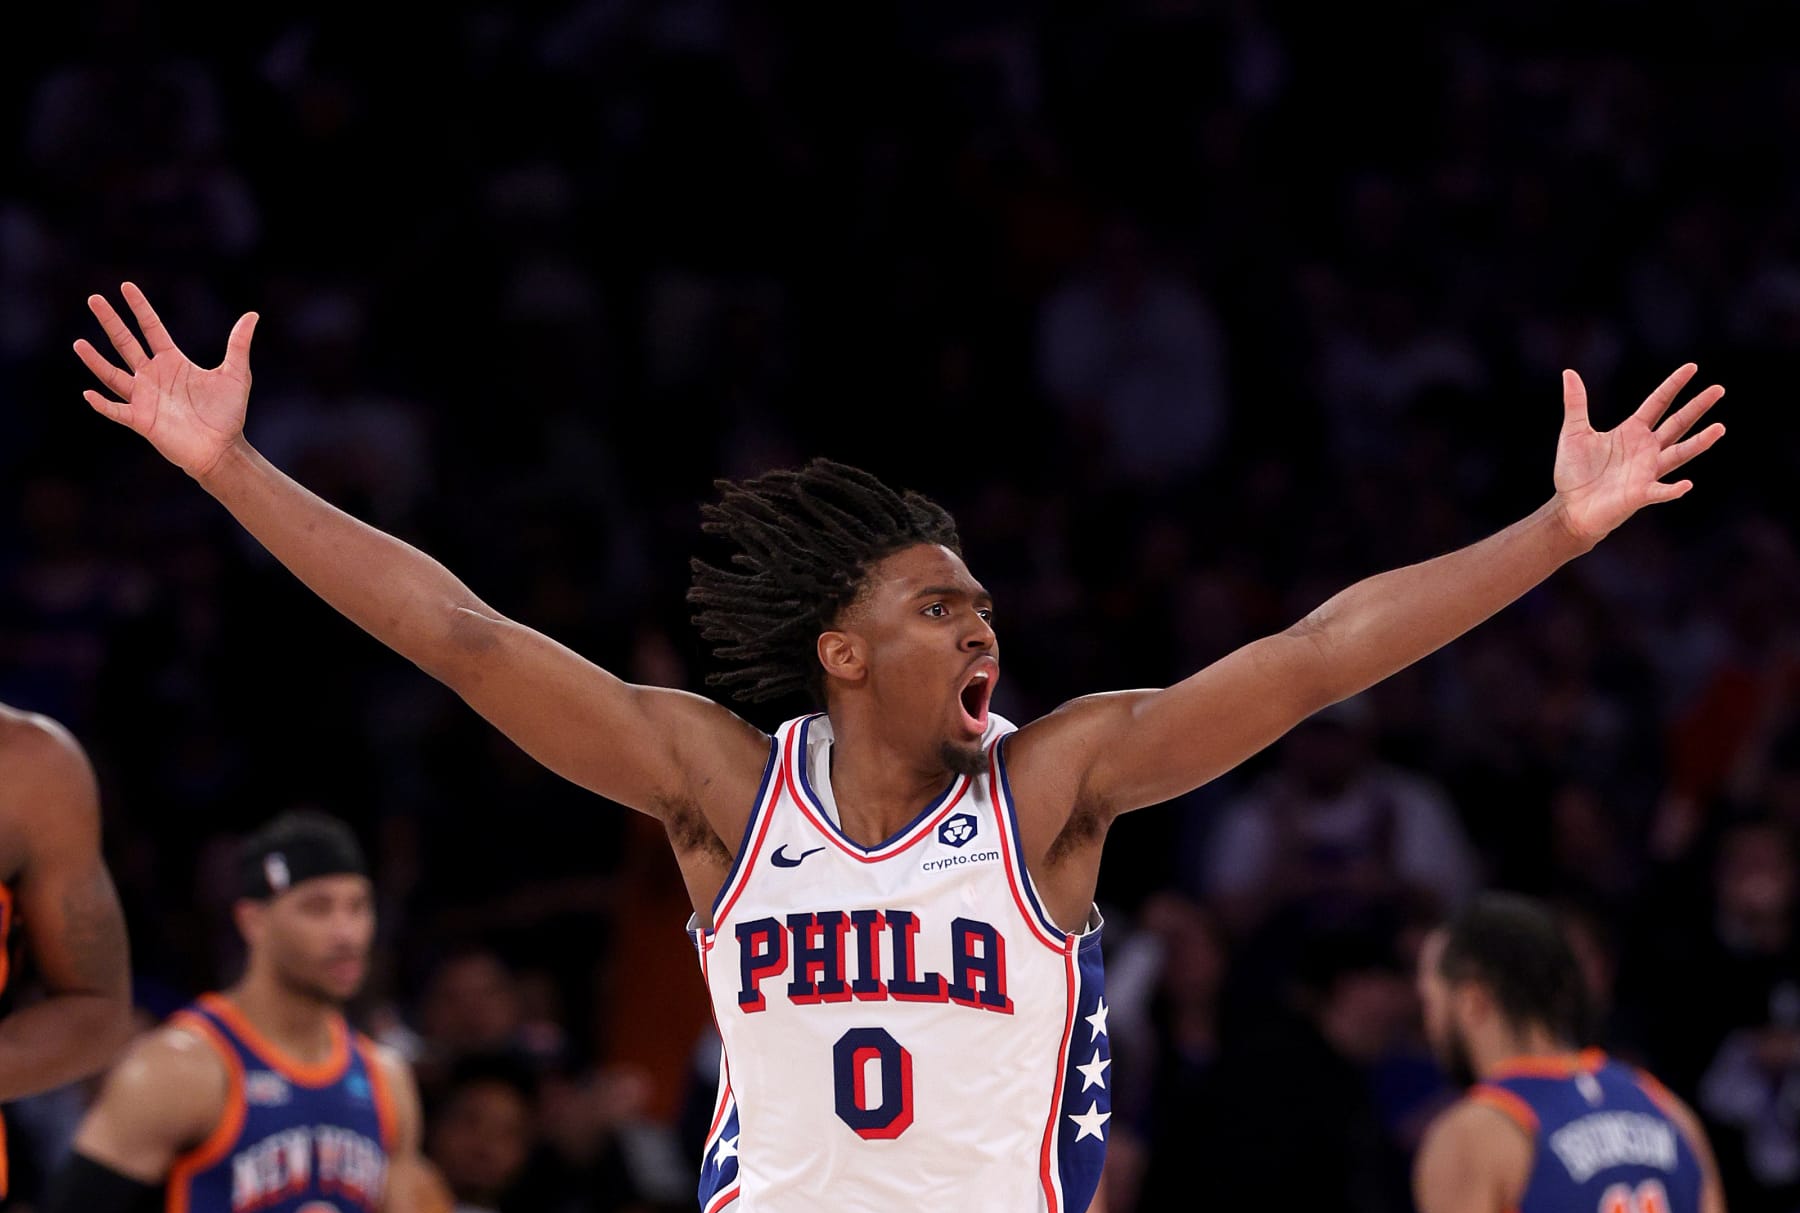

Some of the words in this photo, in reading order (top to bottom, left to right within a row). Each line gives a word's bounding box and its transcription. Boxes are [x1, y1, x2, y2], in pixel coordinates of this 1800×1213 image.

[922, 850, 1000, 871] crypto.com
[735, 909, 1014, 1015] PHILA
[833, 1027, 914, 1140] 0
